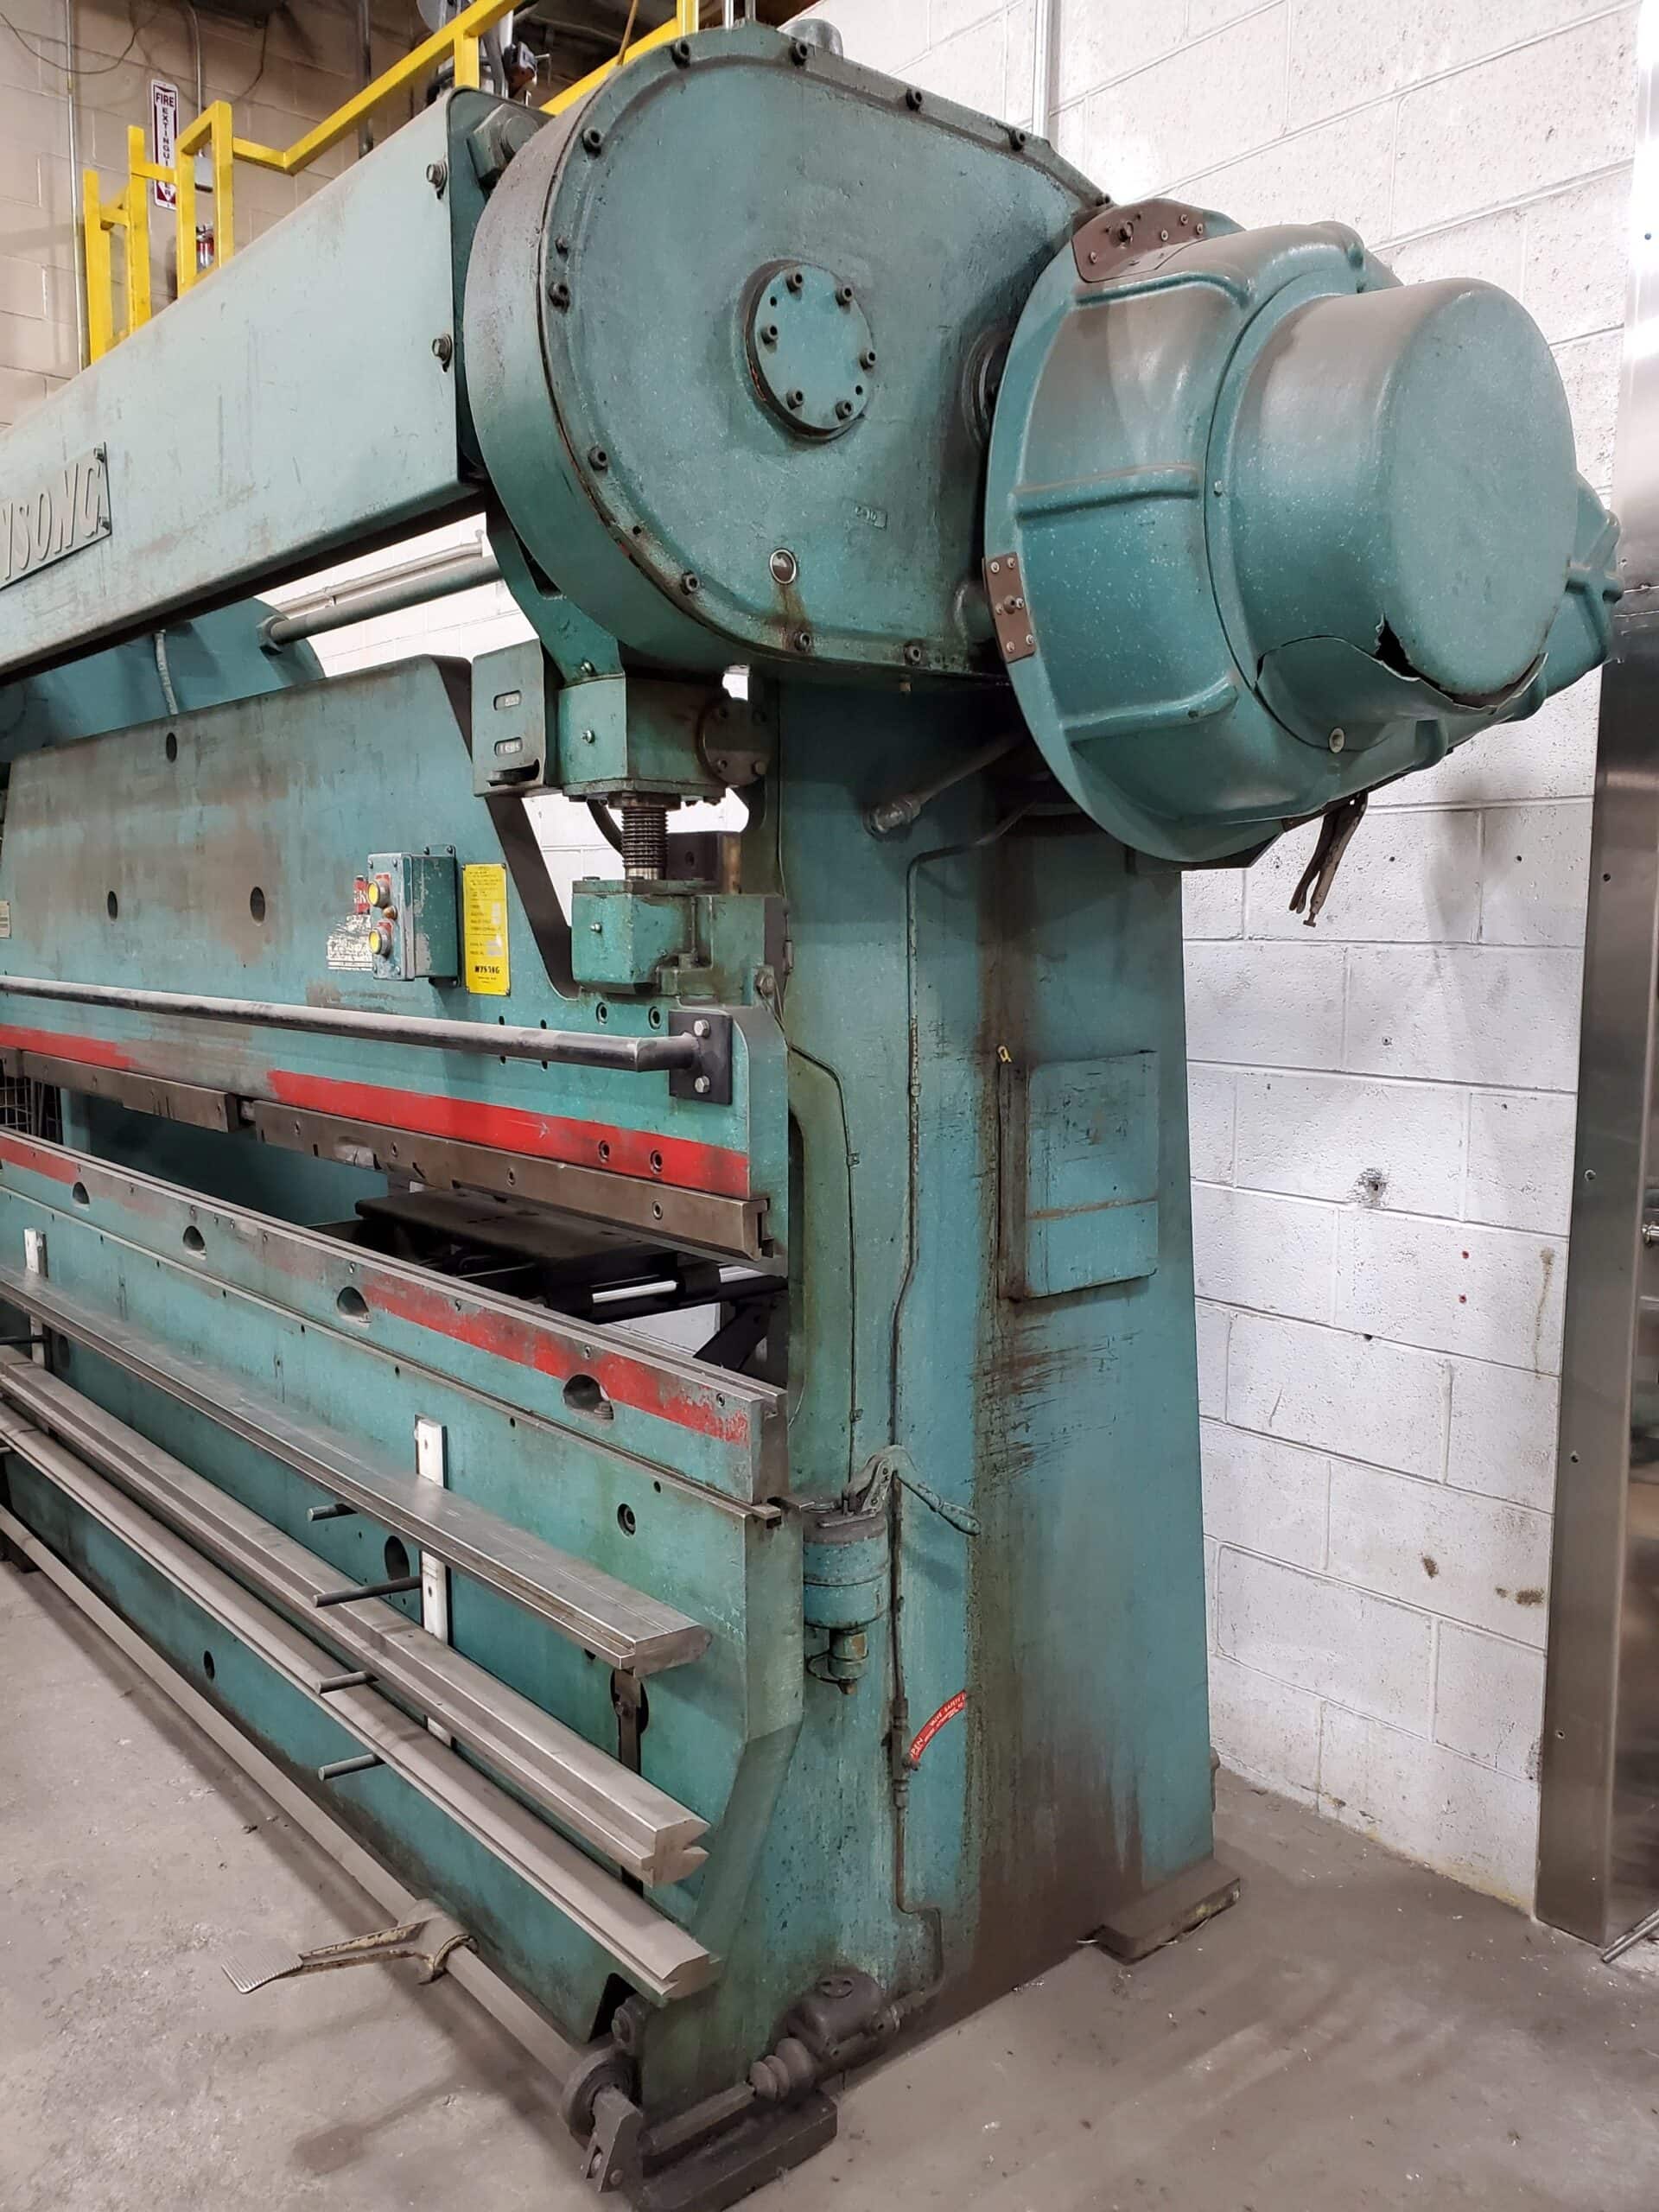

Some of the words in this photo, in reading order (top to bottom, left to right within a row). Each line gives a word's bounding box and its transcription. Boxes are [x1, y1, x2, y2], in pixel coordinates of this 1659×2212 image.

[156, 92, 175, 107] FIRE
[162, 108, 171, 195] EXTINGUIER
[910, 1736, 924, 1758] PEN
